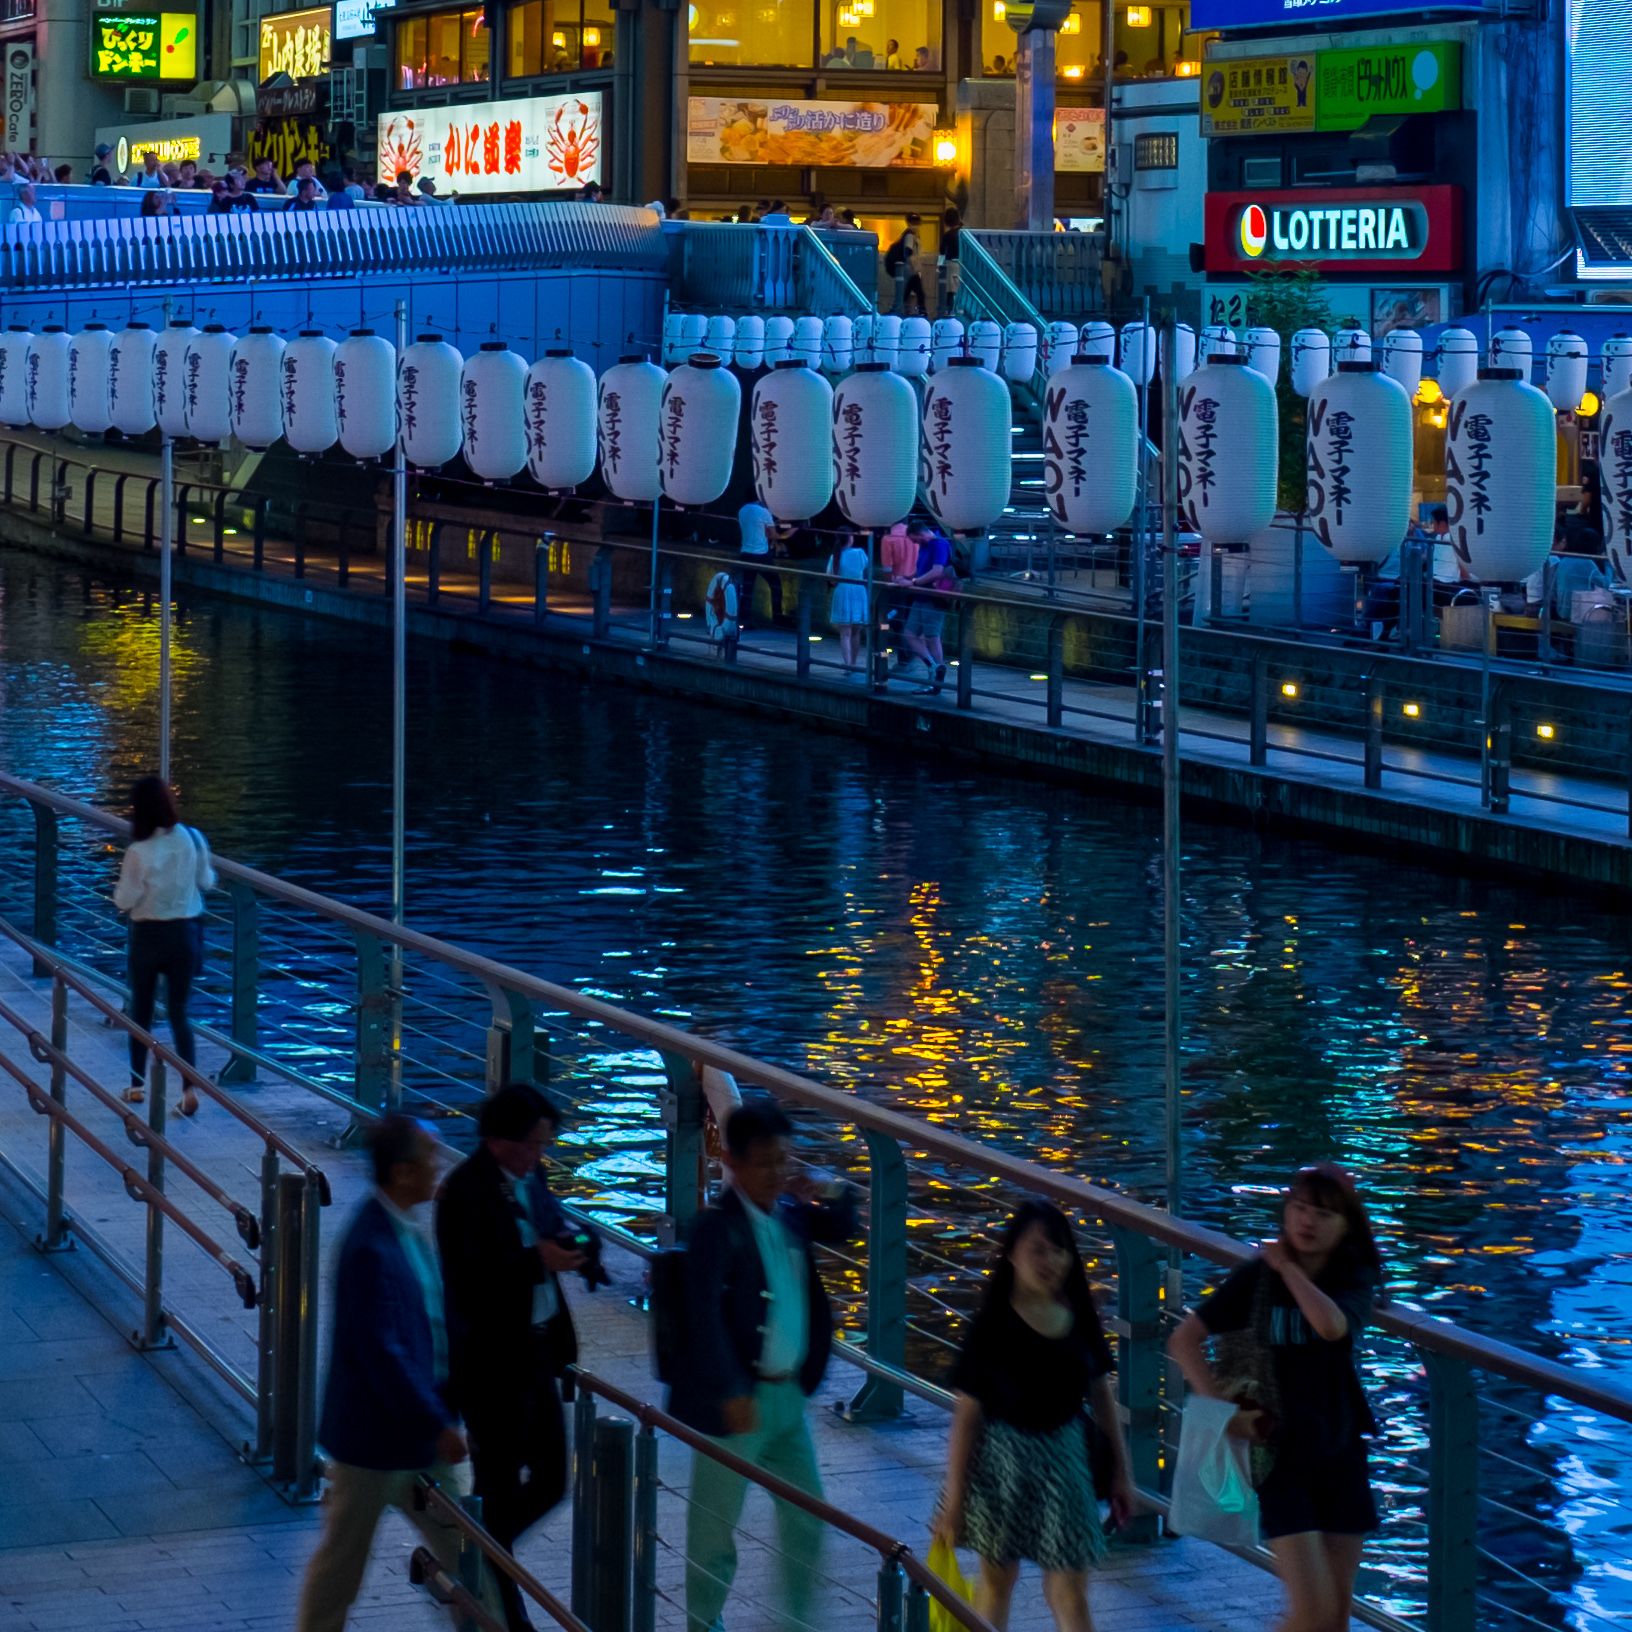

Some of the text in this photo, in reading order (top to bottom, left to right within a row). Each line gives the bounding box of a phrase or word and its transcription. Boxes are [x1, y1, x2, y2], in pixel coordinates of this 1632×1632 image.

[98, 50, 157, 73] ドンキー
[445, 119, 522, 176] かに道楽
[1274, 208, 1408, 251] LOTTERIA
[528, 382, 547, 462] 電子マネー
[842, 403, 864, 497] 電子マネー
[931, 397, 955, 496] 電子マネー
[1065, 399, 1092, 498] 電子マネー
[1193, 397, 1220, 507] 電子マネー
[1325, 411, 1356, 526] 電子マネー
[1464, 414, 1495, 535] 電子マネー
